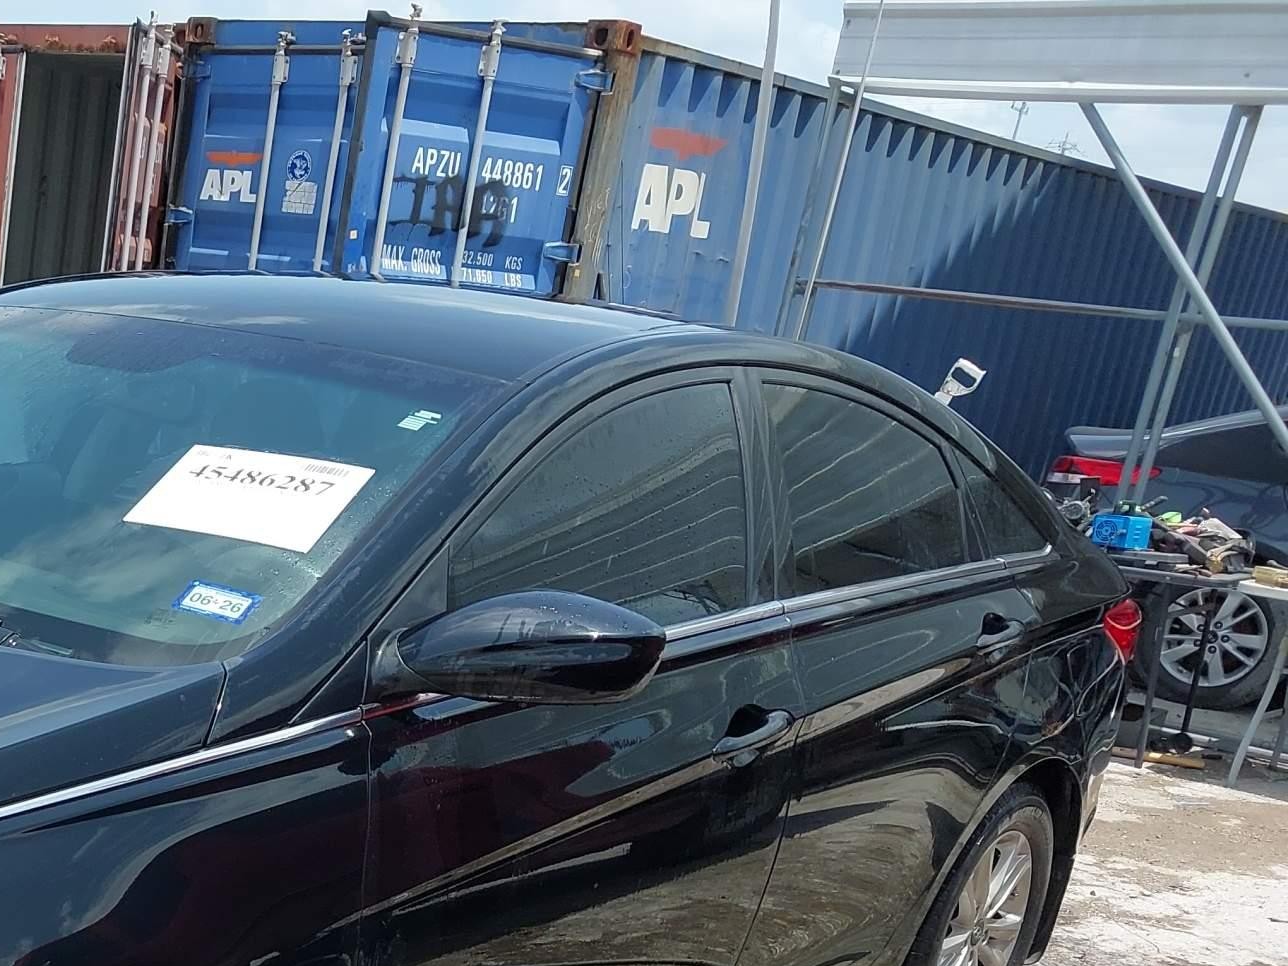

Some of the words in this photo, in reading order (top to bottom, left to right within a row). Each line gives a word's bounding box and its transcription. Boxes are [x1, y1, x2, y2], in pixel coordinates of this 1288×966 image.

[199, 168, 257, 203] APL
[411, 147, 462, 178] APZU
[481, 157, 544, 192] 448861
[557, 167, 572, 195] 2
[631, 163, 710, 239] APL
[381, 243, 408, 272] MAX.
[411, 247, 442, 276] GROSS
[504, 255, 524, 271] KGS
[504, 272, 523, 288] LBS
[189, 463, 336, 496] 45486287
